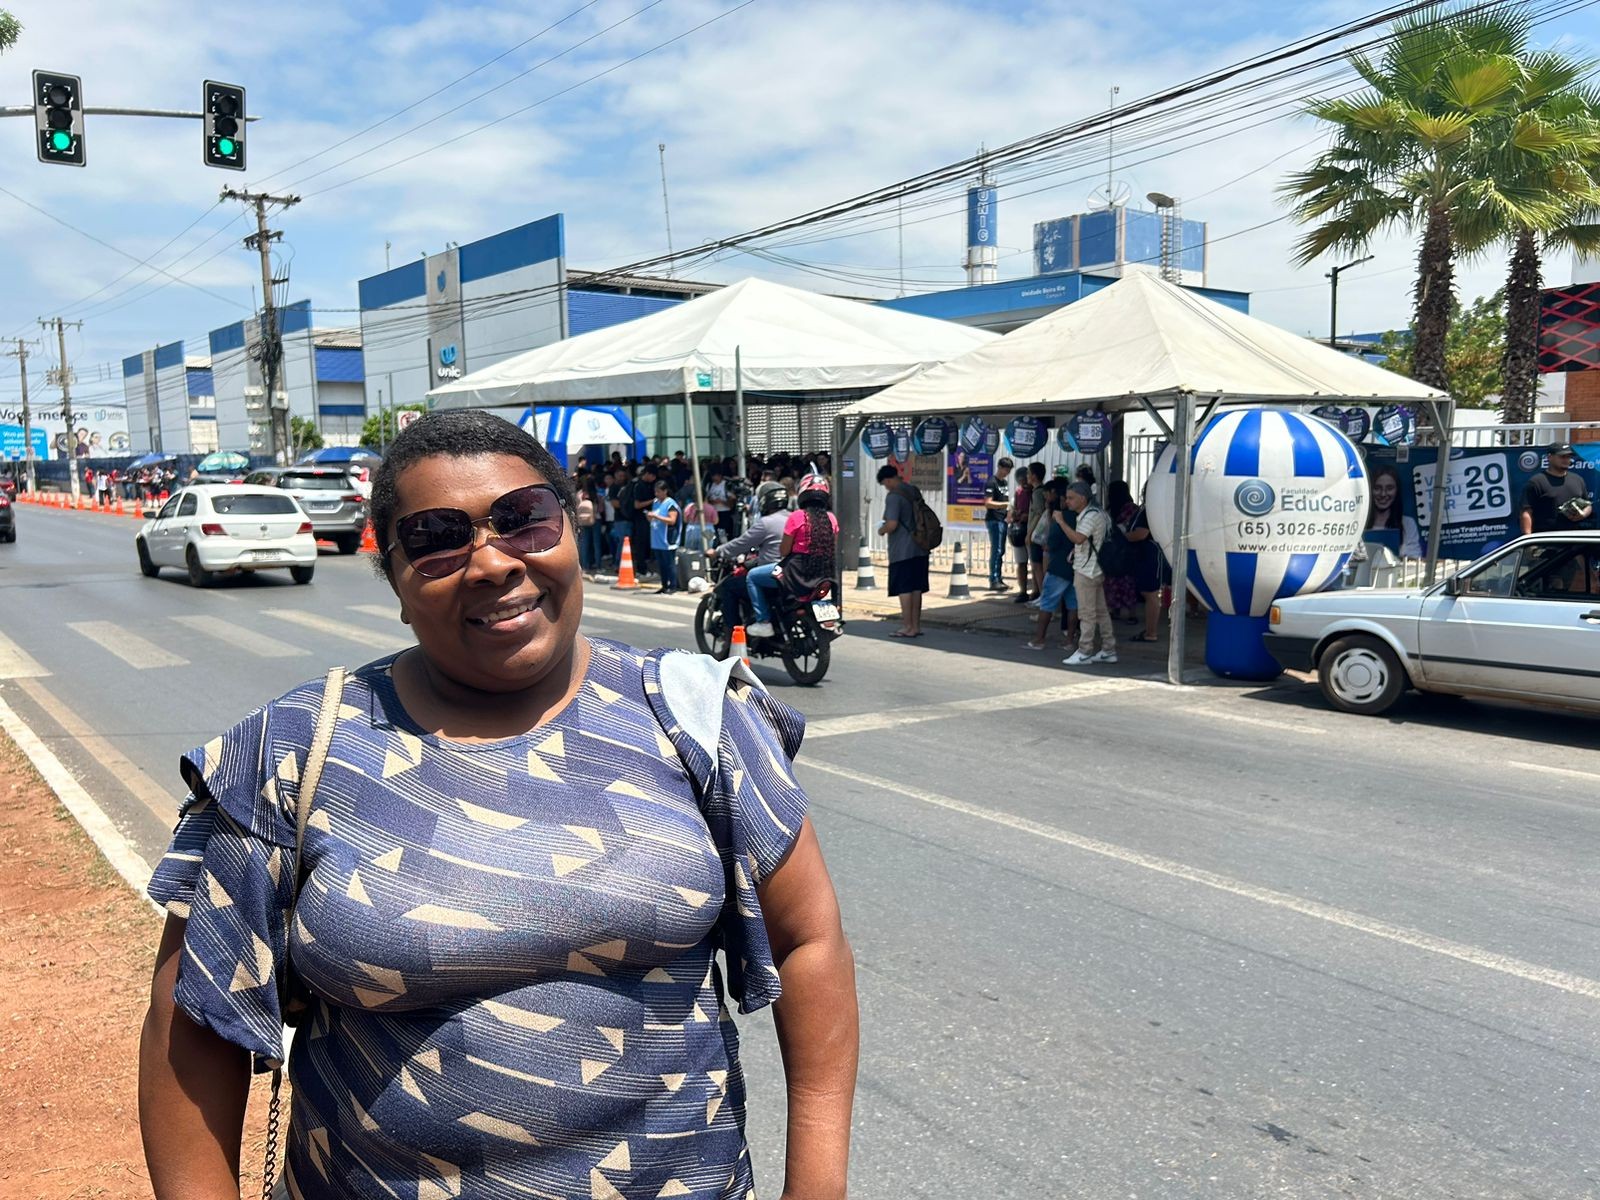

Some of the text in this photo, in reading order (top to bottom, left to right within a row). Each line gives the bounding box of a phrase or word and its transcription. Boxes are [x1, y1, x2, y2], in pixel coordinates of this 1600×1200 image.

[437, 365, 460, 378] unic
[38, 410, 88, 421] merce
[1464, 463, 1504, 488] 20
[1466, 486, 1506, 511] 26
[1238, 521, 1351, 538] (65) 3026-5661
[1460, 524, 1508, 534] Transforma.
